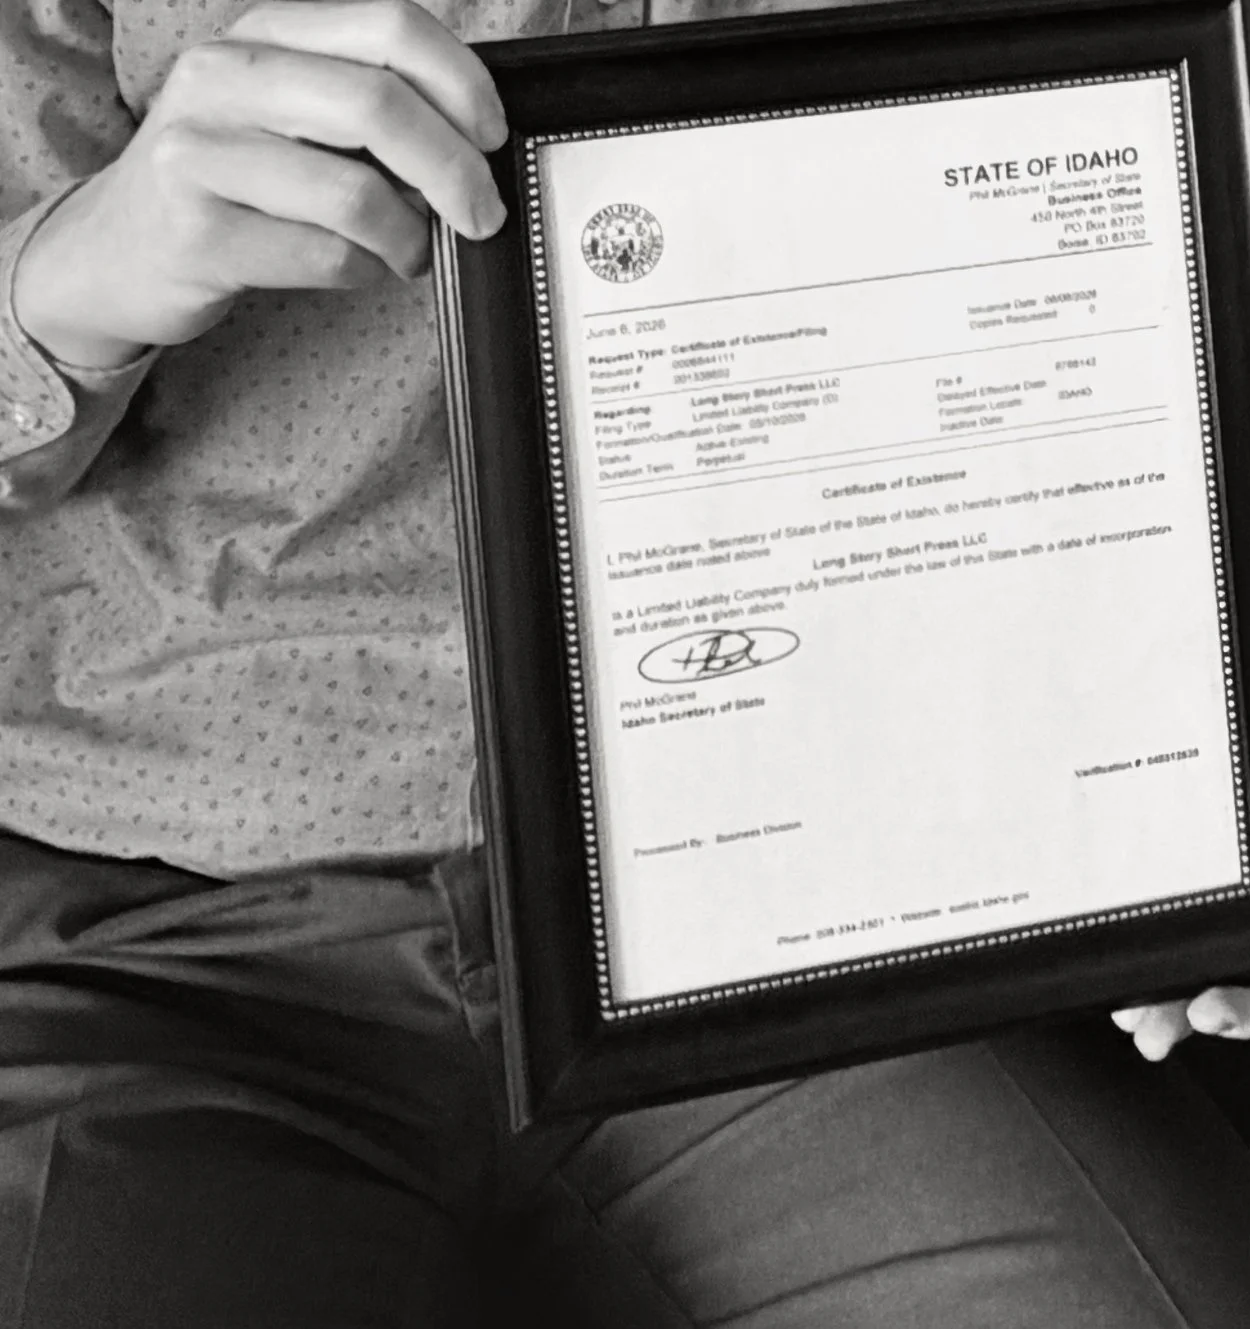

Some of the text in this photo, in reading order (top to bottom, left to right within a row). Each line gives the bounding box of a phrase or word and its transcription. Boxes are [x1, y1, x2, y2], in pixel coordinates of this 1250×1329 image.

[944, 147, 1138, 187] STATE OF IDAHO
[1050, 178, 1097, 191] Secretary
[1115, 172, 1141, 183] State
[1048, 186, 1142, 206] Business Office
[1056, 206, 1086, 221] North
[1110, 200, 1143, 213] Street
[1064, 222, 1081, 233] PO
[586, 327, 617, 340] June
[588, 351, 635, 366] Request
[670, 339, 727, 355] Certificate
[594, 377, 841, 420] Regarding Long Story Short Press LLC
[772, 395, 820, 411] Company
[822, 470, 967, 501] Certificate of Existence
[618, 551, 642, 564] Phil
[708, 532, 767, 550] Secretary
[770, 528, 783, 540] of
[785, 524, 817, 538] State
[819, 521, 832, 533] of
[834, 518, 853, 530] the
[857, 513, 887, 525] State
[890, 509, 903, 522] of
[962, 496, 1002, 513] hereby
[1004, 490, 1040, 508] certify
[1042, 485, 1066, 499] that
[1067, 479, 1115, 496] effective
[1118, 477, 1131, 488] as
[1133, 473, 1145, 485] of
[813, 532, 988, 571] Long Story Short Press LLC
[608, 563, 663, 581] issuance
[666, 558, 694, 572] date
[699, 553, 731, 567] noted
[638, 599, 682, 617] Limited
[685, 593, 731, 612] Liability
[734, 585, 792, 603] Company
[795, 579, 820, 593] duly
[823, 572, 865, 587] formed
[867, 564, 902, 581] under
[904, 561, 924, 575] the
[949, 554, 962, 568] of
[988, 547, 1018, 562] State
[1021, 543, 1044, 557] with
[1058, 536, 1083, 550] date
[1086, 533, 1098, 546] of
[613, 623, 637, 636] and
[640, 615, 691, 632] duration
[693, 614, 708, 624] as
[711, 607, 745, 624] given
[622, 696, 766, 730] Idaho Secretary of State
